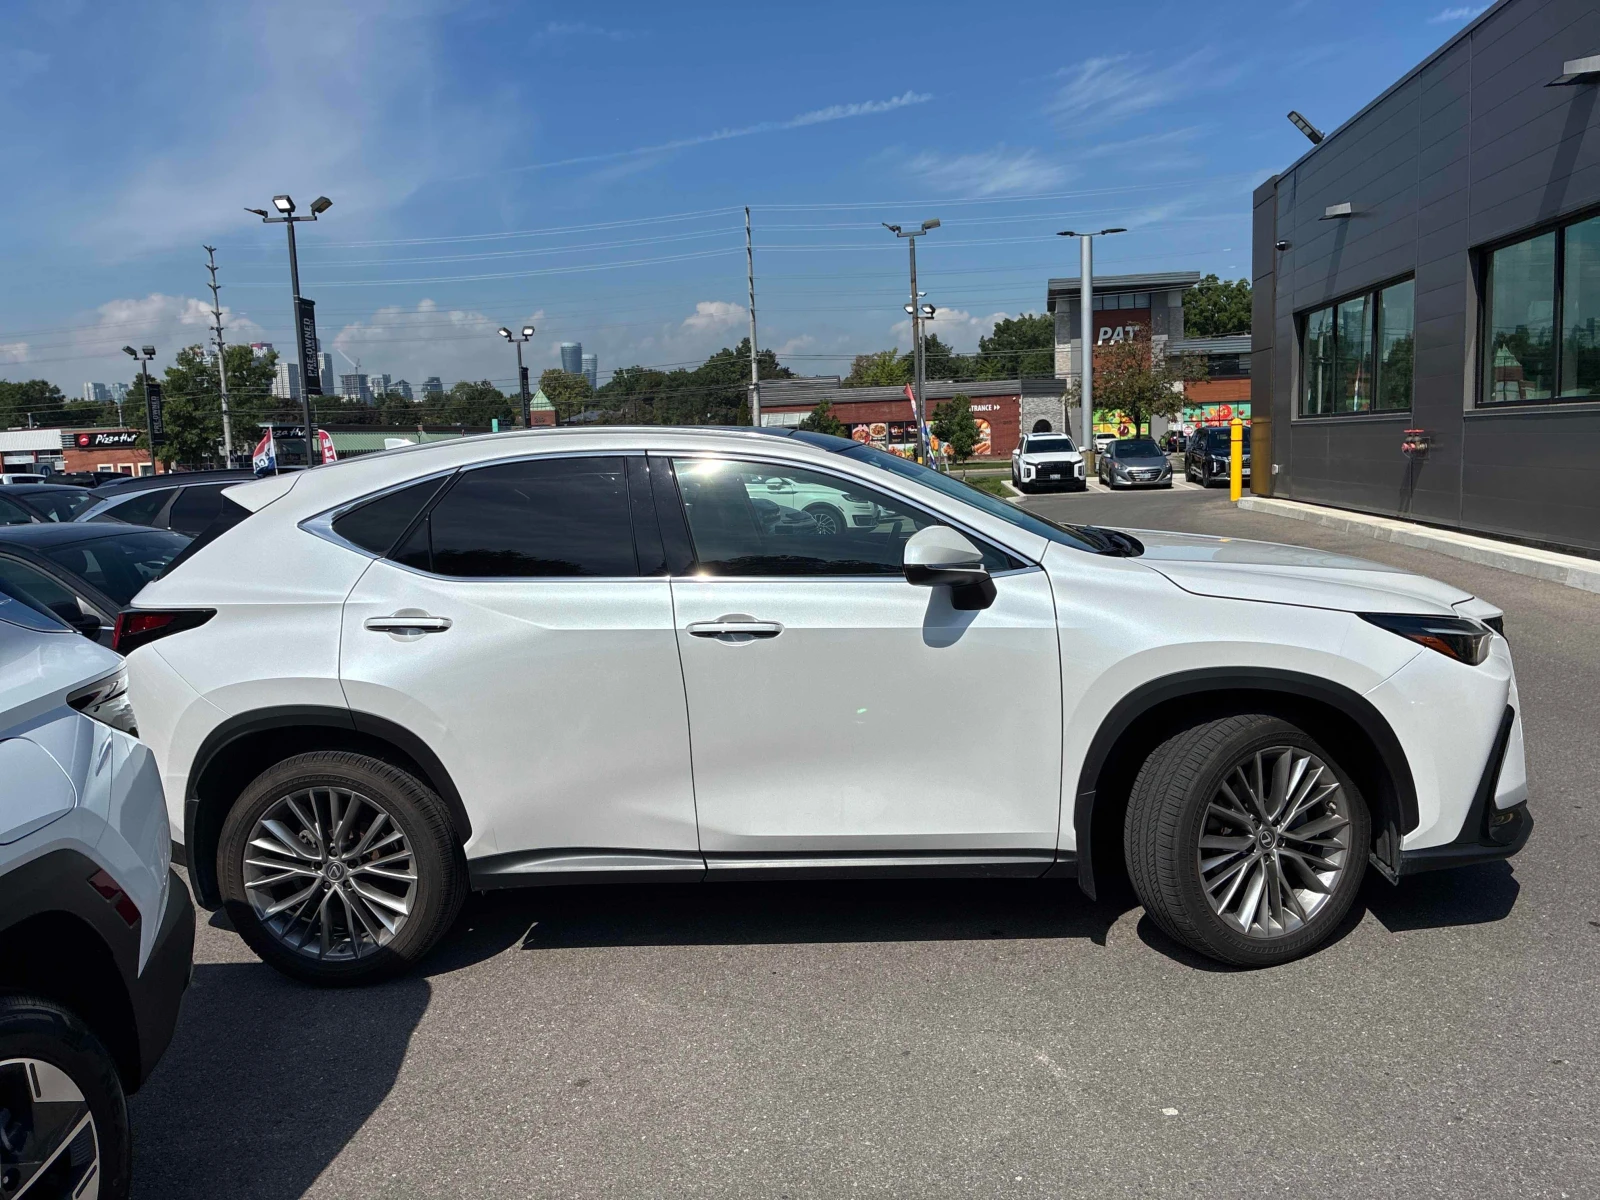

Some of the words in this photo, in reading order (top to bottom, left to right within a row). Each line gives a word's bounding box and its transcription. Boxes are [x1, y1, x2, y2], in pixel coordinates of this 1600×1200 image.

[1097, 326, 1140, 346] PAT
[304, 318, 315, 377] PRE-OWNED
[151, 395, 160, 434] PRE-OWNED
[969, 404, 992, 412] TRANCE
[95, 433, 119, 445] Pizza
[119, 432, 138, 442] Hut
[261, 428, 288, 437] Pzza
[290, 427, 306, 437] Hu
